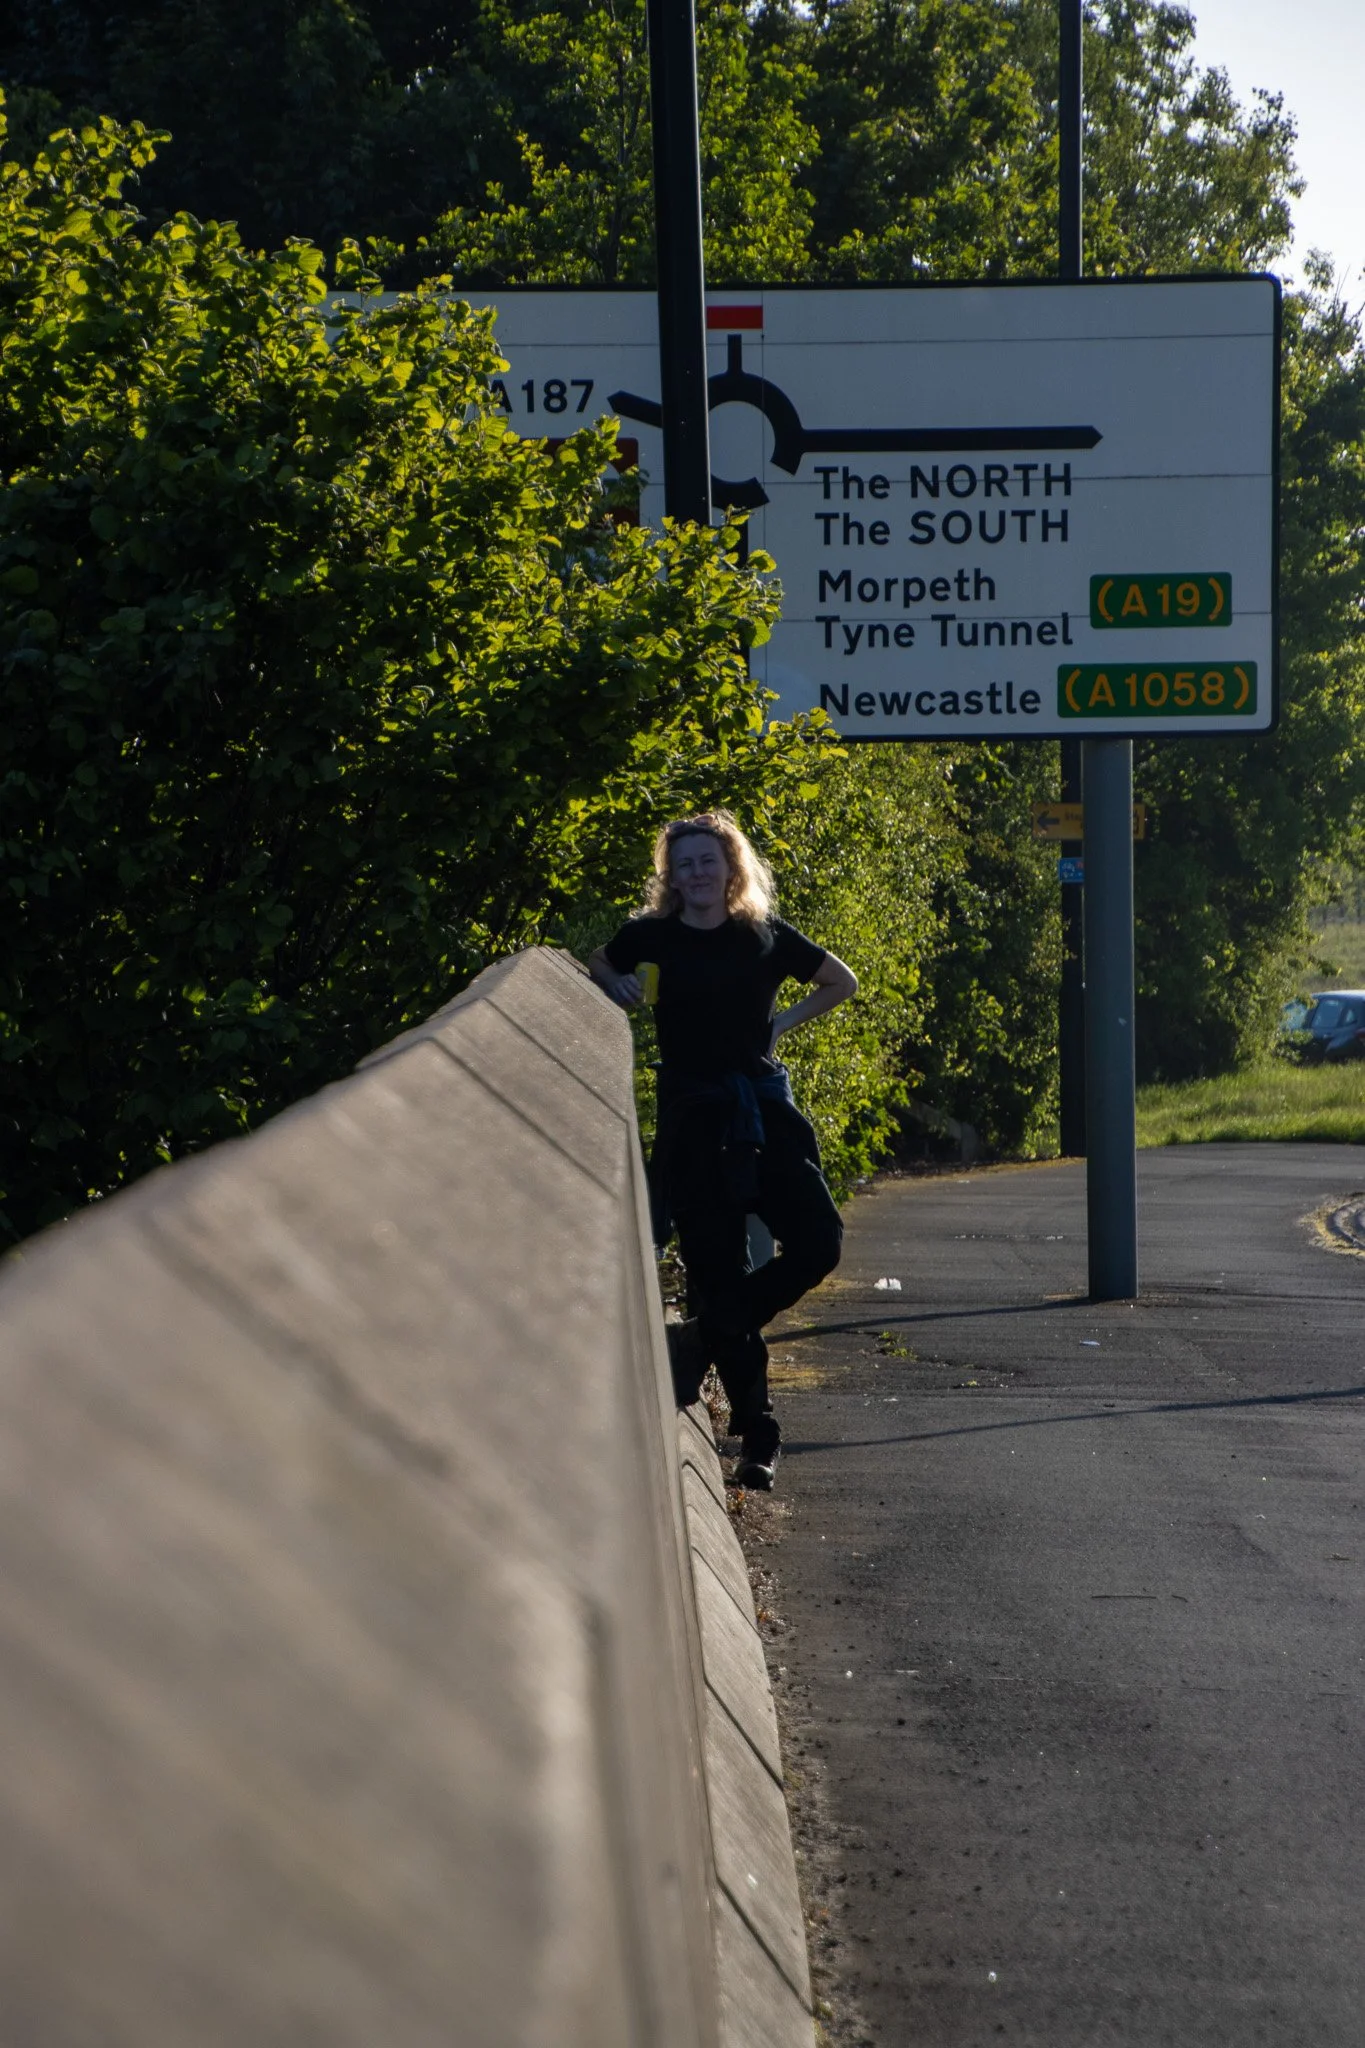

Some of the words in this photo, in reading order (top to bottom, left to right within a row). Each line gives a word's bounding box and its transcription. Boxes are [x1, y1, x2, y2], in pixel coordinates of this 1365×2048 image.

[814, 466, 890, 499] The
[910, 463, 1071, 498] NORTH
[815, 512, 890, 545] The
[909, 509, 1068, 545] SOUTH
[818, 567, 996, 609] Morpeth
[815, 615, 915, 655] Tyne
[931, 612, 1073, 647] Tunnel
[819, 681, 1041, 716] Newcastle
